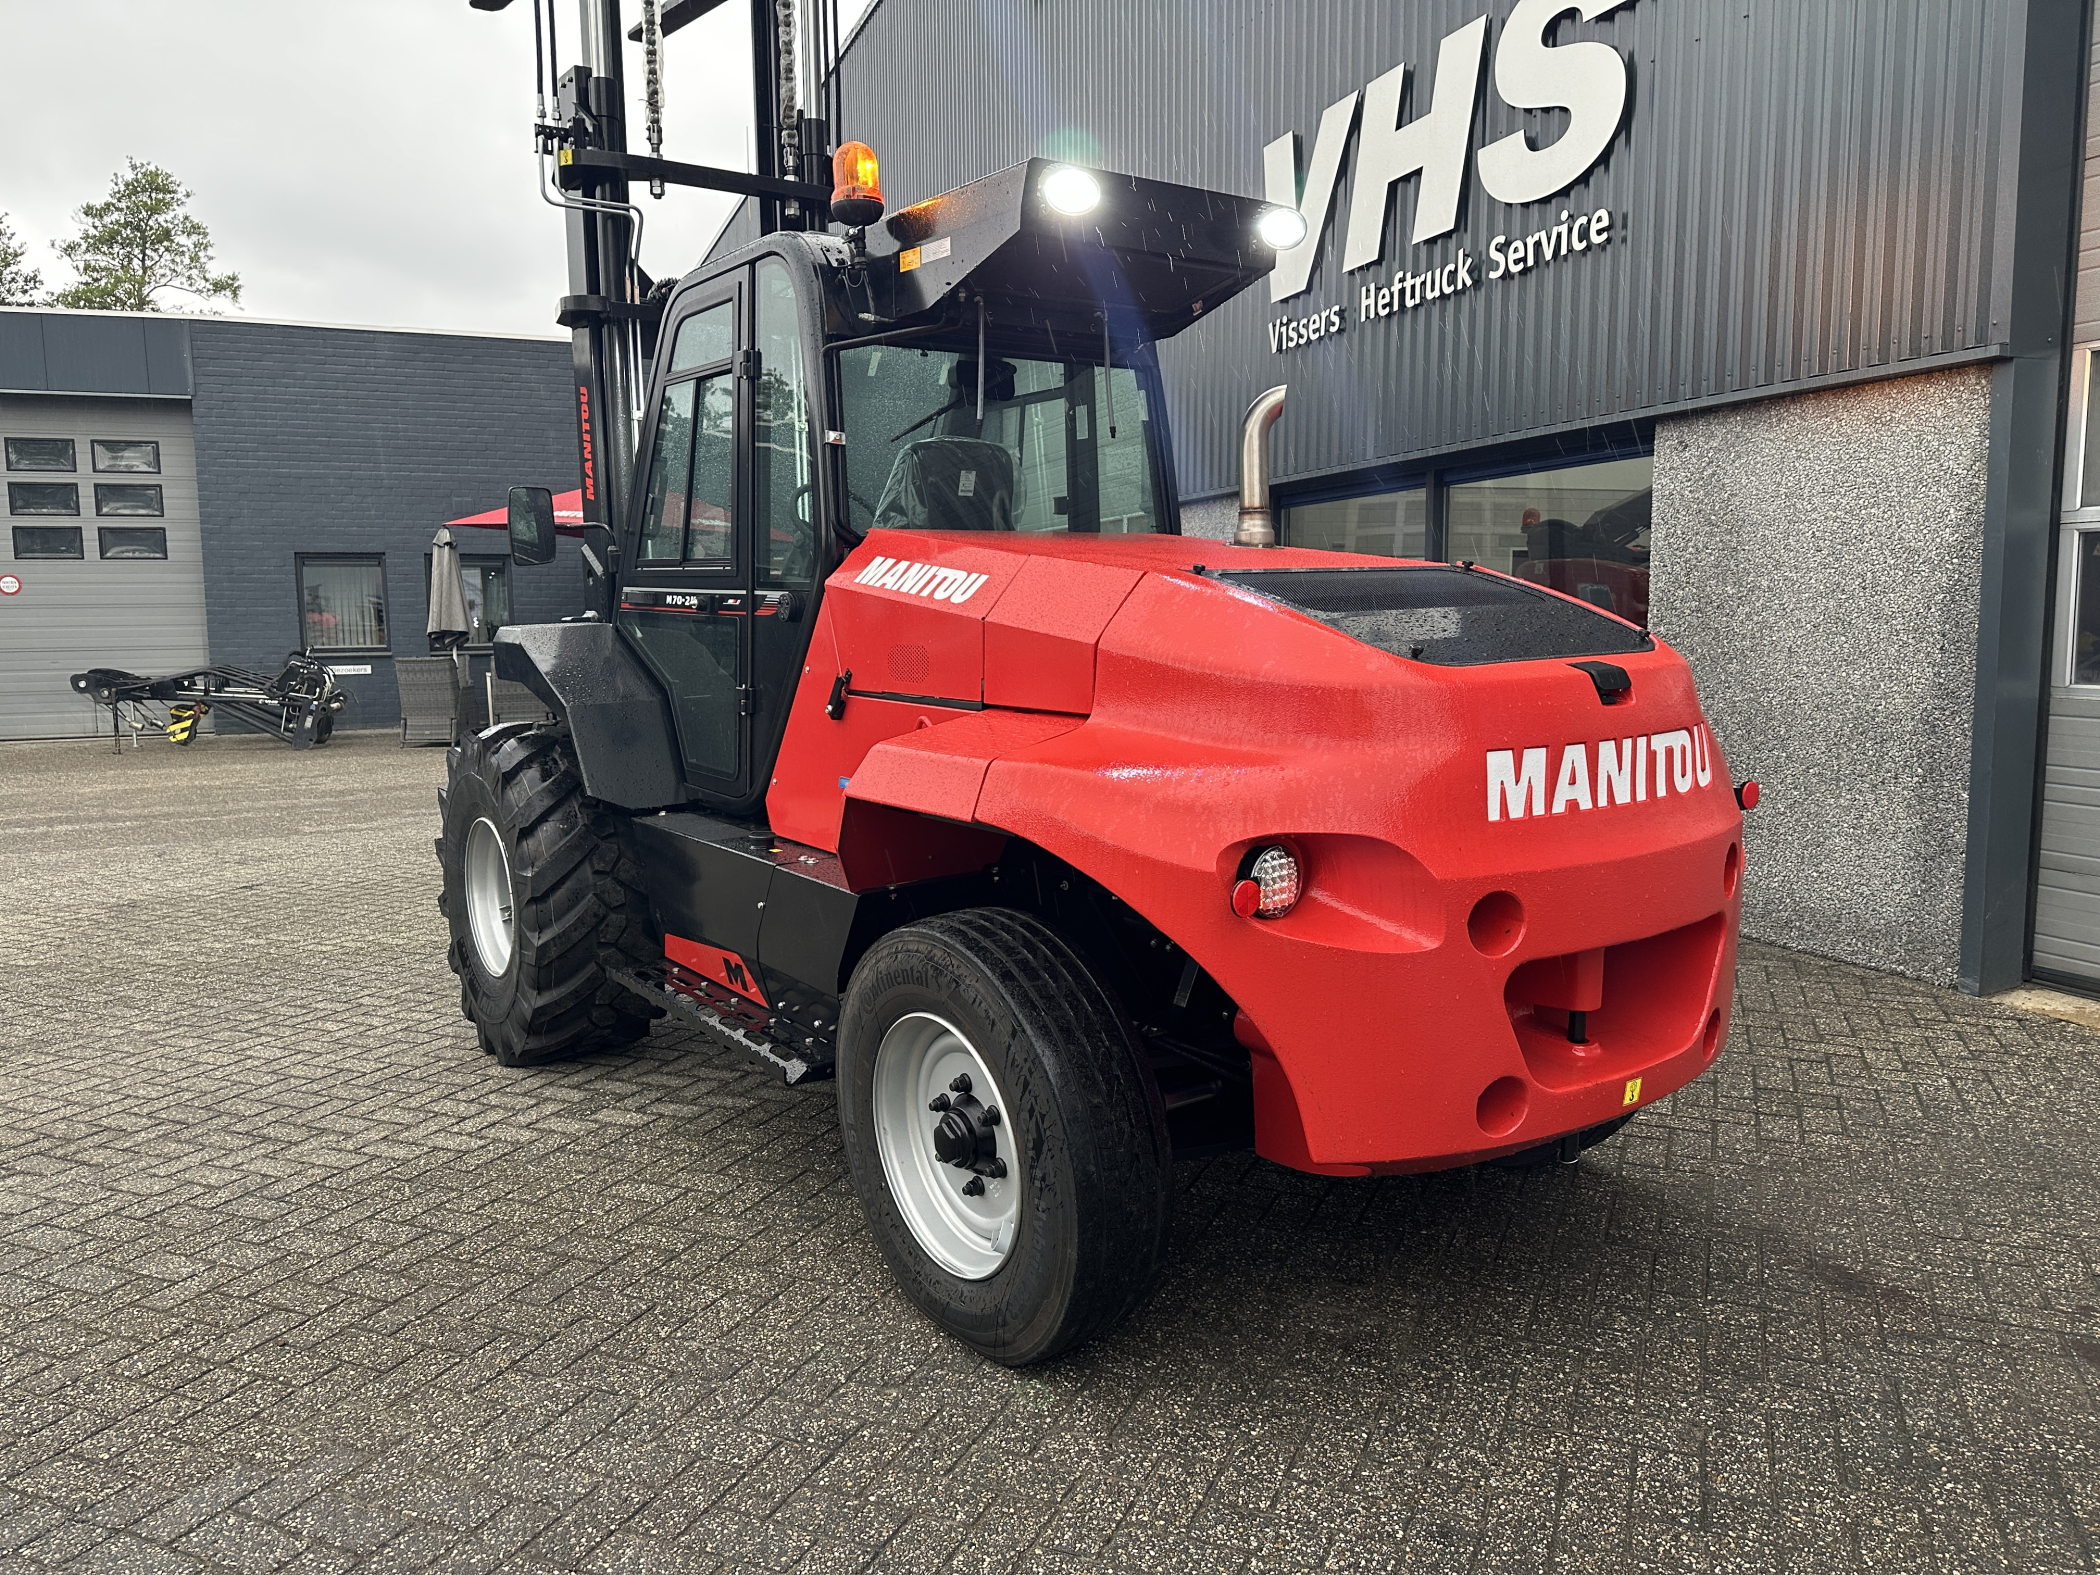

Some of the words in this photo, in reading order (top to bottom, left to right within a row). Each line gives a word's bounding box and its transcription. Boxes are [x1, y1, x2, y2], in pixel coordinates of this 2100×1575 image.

[1263, 0, 1627, 304] VHS
[1268, 304, 1340, 354] Vissers
[1360, 247, 1474, 323] Heftruck
[1488, 208, 1610, 279] Service
[580, 386, 595, 501] MANITOU
[853, 555, 990, 604] MANITOU
[1486, 723, 1711, 822] MANITOU
[722, 956, 749, 993] M
[859, 964, 930, 1016] Continental
